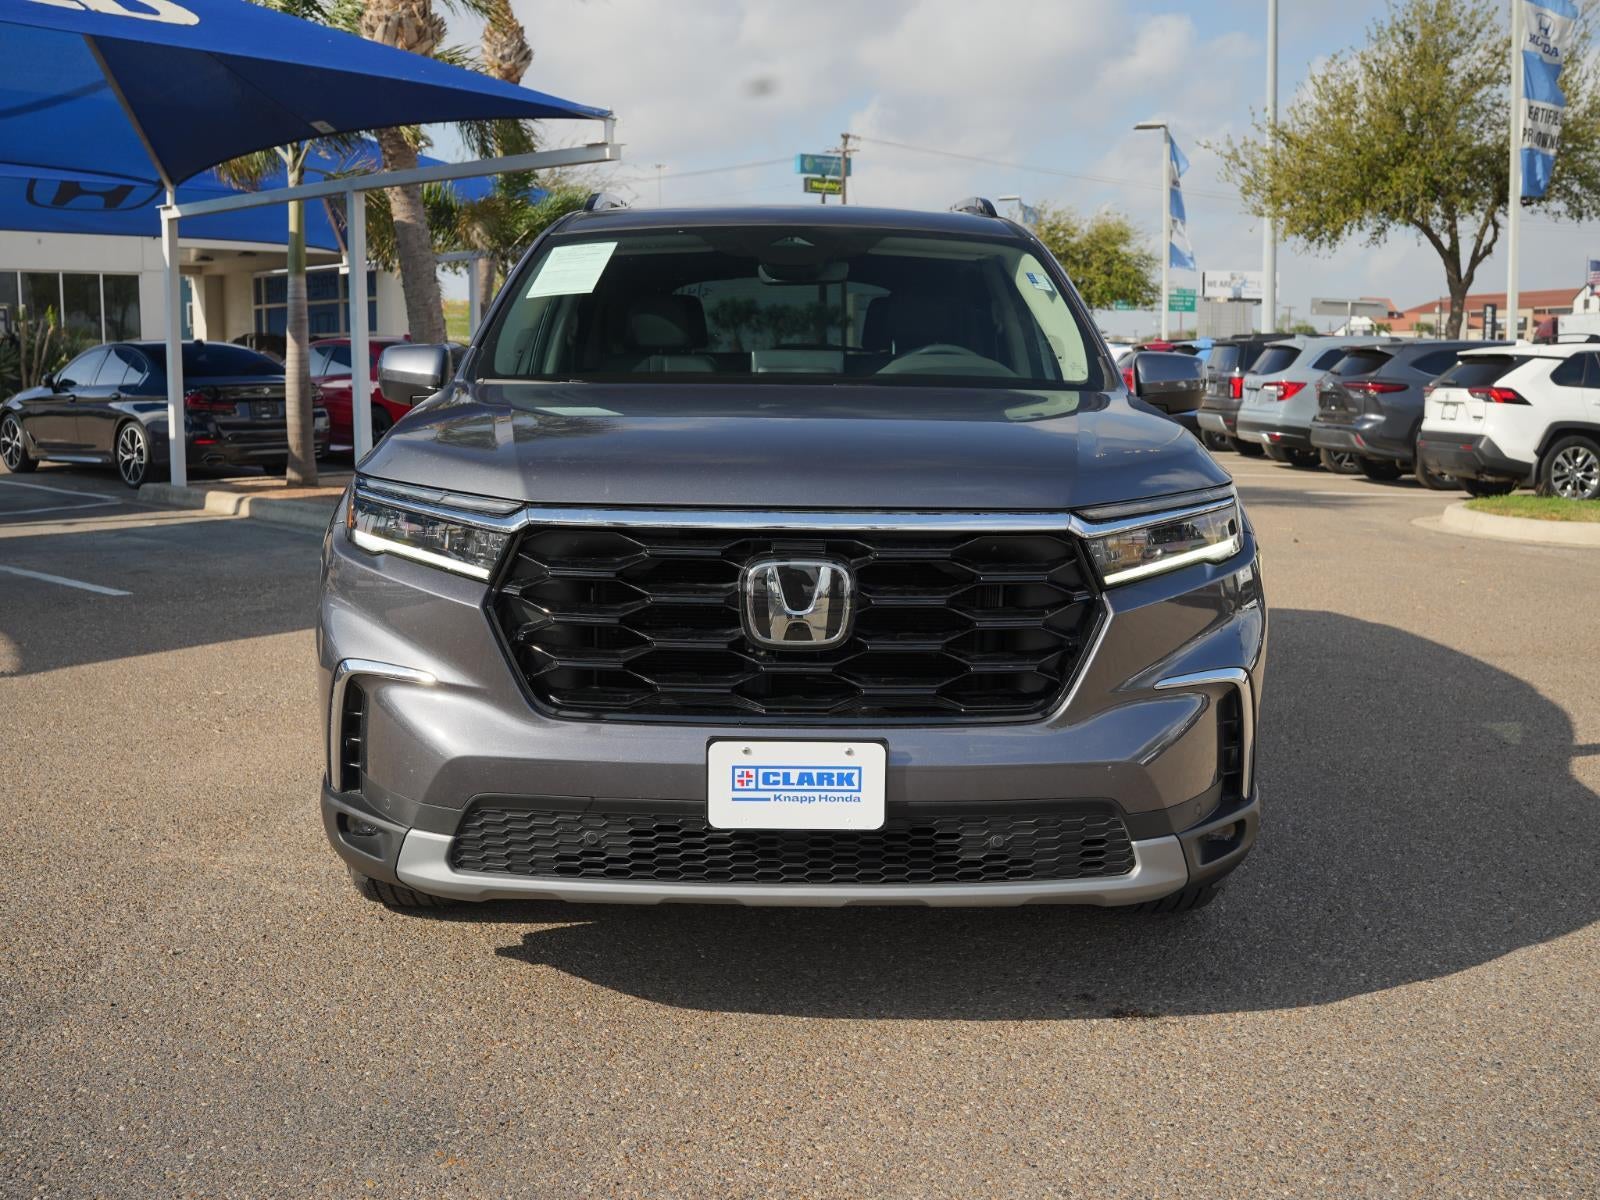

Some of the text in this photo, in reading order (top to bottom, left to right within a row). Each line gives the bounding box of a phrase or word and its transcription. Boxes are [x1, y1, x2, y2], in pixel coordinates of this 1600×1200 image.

[1528, 106, 1563, 127] ERTIFIE
[762, 771, 856, 787] CLARK
[773, 794, 861, 804] Knapp Honda
